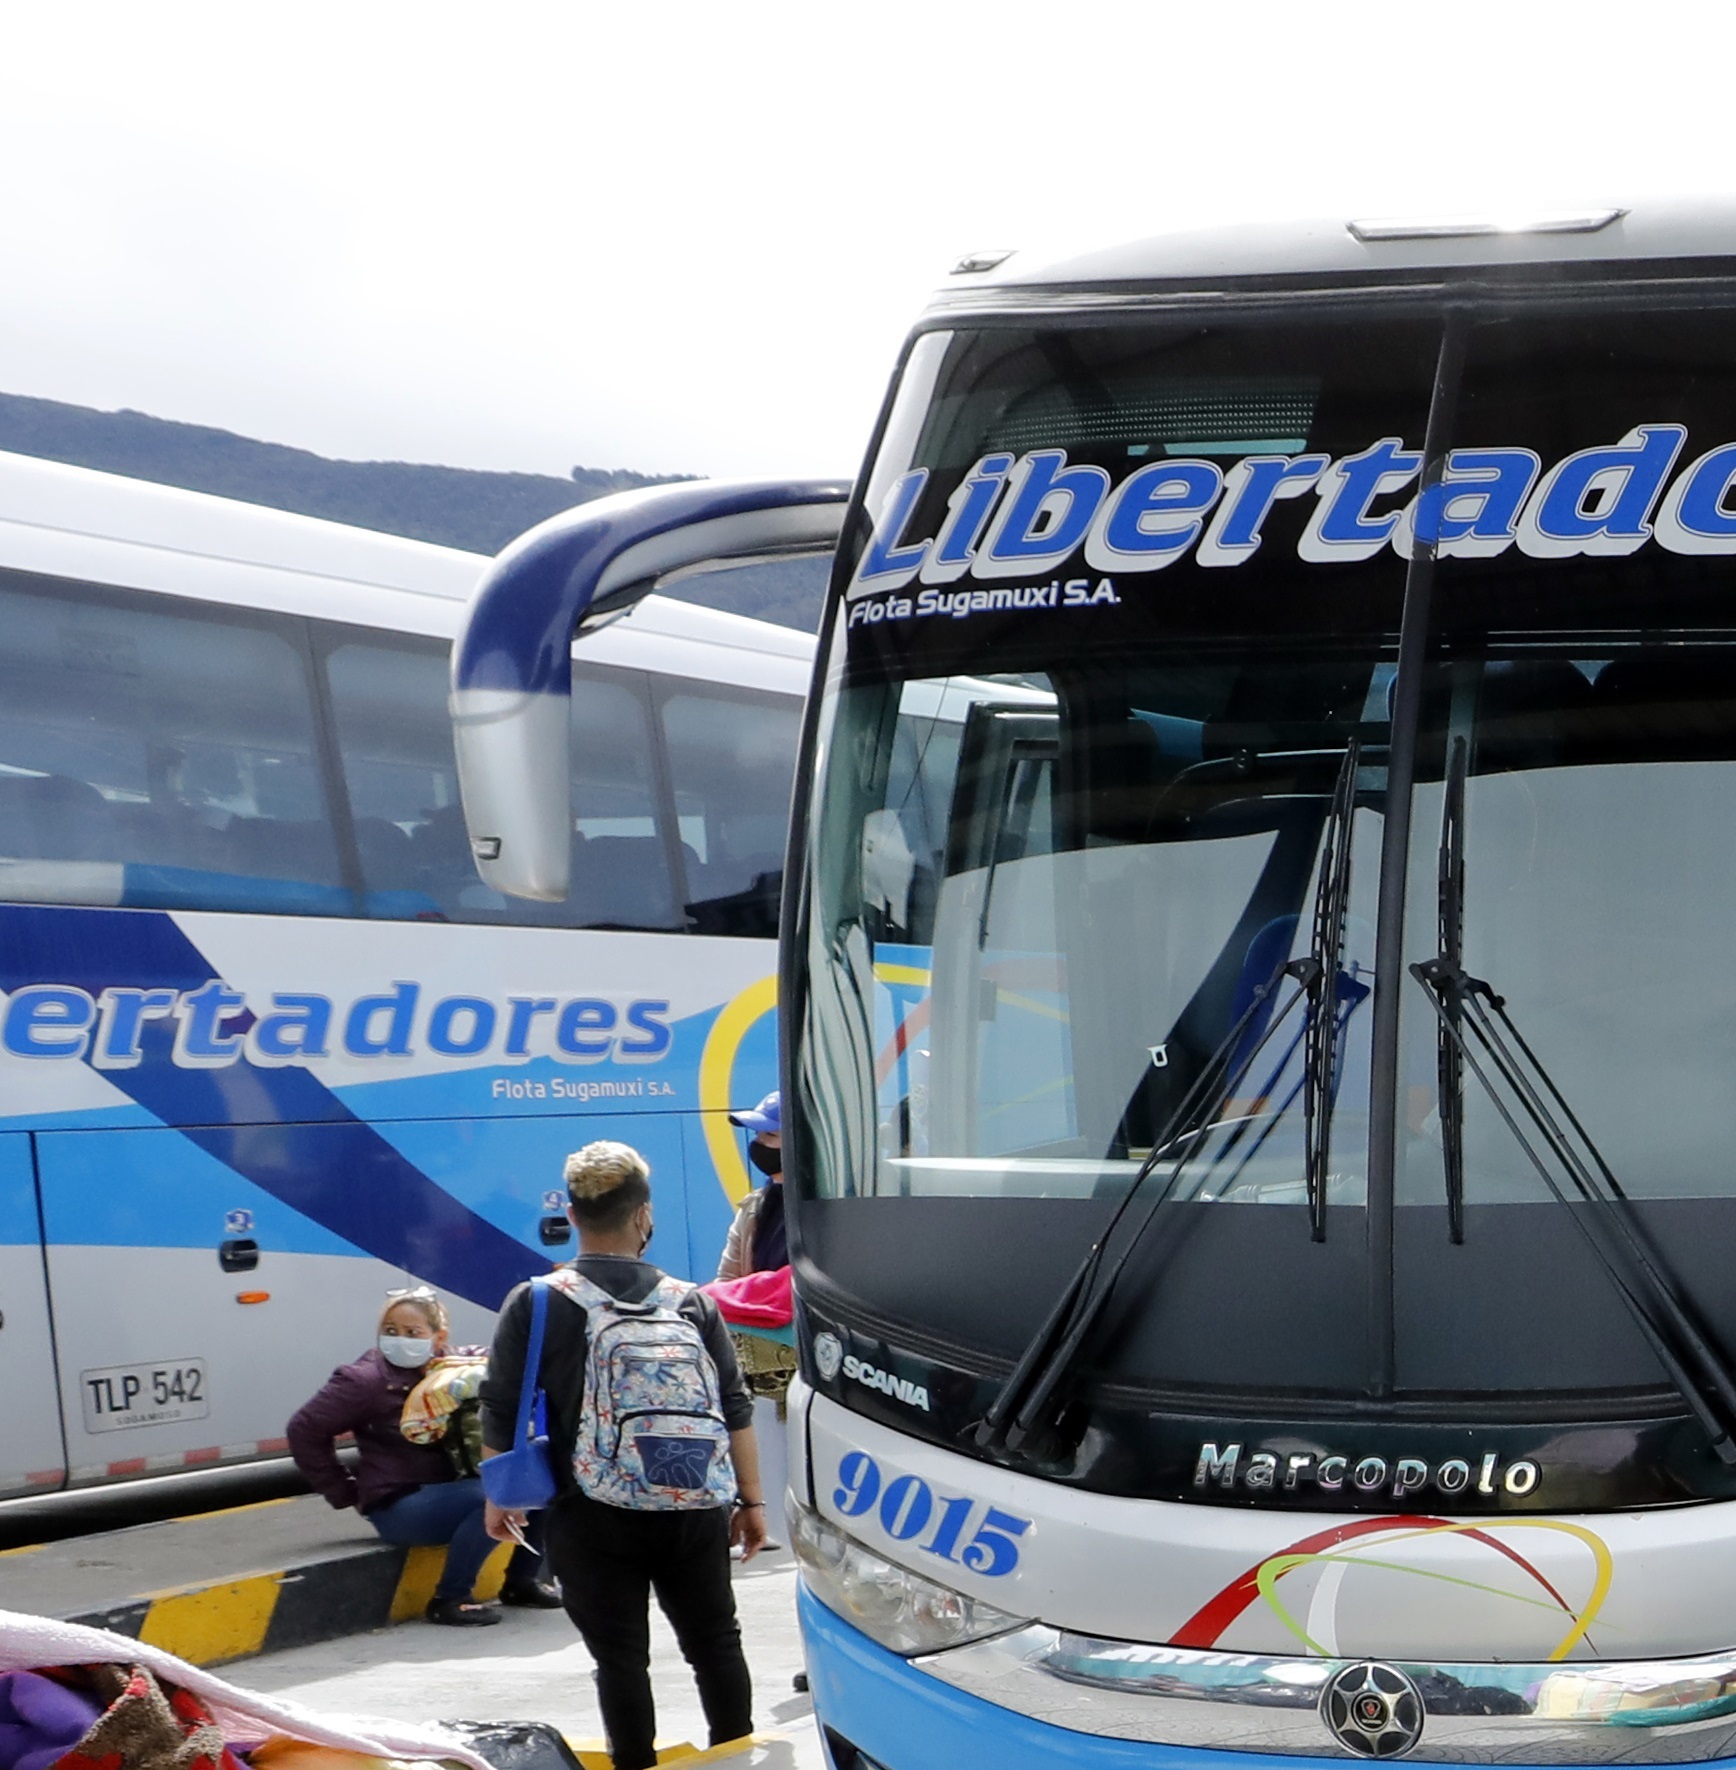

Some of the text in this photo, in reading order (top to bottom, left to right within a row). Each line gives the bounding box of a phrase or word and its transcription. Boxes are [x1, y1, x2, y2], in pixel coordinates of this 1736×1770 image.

[849, 578, 1121, 628] Flota Sugamuxi S.A.
[1, 979, 673, 1068] ertadores
[493, 1077, 676, 1101] Flota Sugamuxi S.A.
[87, 1368, 203, 1414] TLP 542
[843, 1354, 930, 1412] SCANIA
[1195, 1442, 1543, 1498] Marcopolo
[832, 1448, 1034, 1579] 9015
